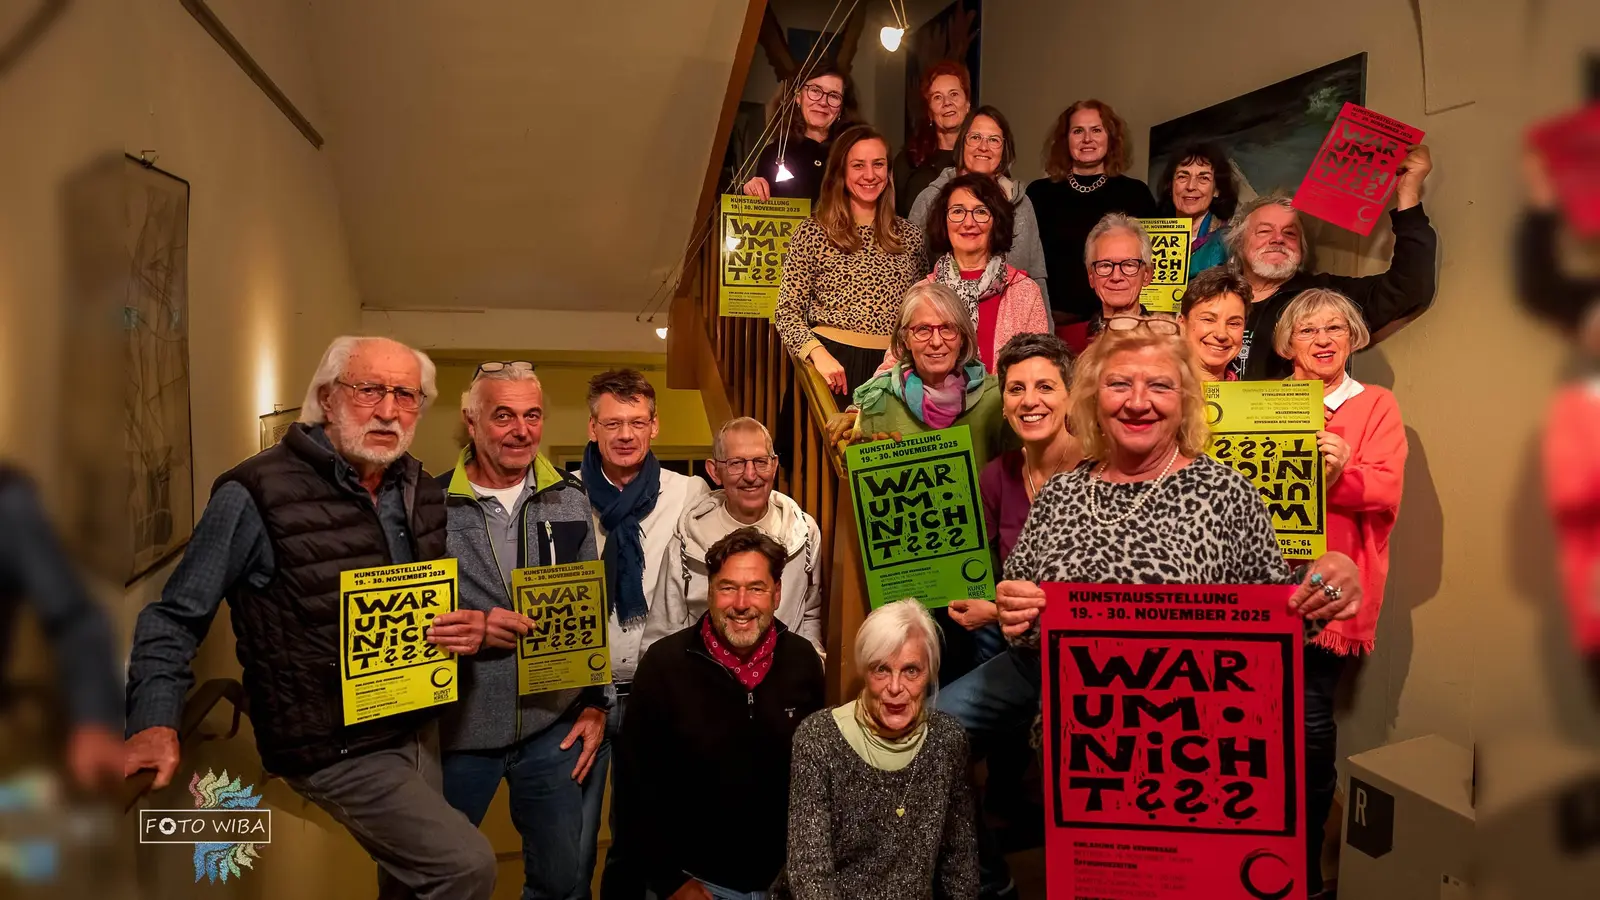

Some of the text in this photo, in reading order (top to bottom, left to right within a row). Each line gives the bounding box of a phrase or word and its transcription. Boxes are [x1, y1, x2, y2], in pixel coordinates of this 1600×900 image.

[1343, 124, 1398, 158] WAR
[730, 218, 792, 238] WAR
[860, 434, 942, 455] KUNSTAUSSTELLUNG
[861, 454, 873, 463] 19.
[879, 452, 892, 460] 30.
[893, 446, 938, 458] NOVEMBER
[939, 441, 958, 450] 2025
[862, 464, 956, 497] WAR
[1278, 538, 1291, 546] 30.
[1298, 538, 1311, 546] 19.
[1276, 548, 1312, 556] KUNST
[354, 564, 432, 579] KUNSTAUSSTELLUNG
[355, 578, 366, 586] 19.
[372, 576, 384, 584] 30.
[386, 572, 428, 583] NOVEMBER
[429, 569, 446, 578] 2025
[524, 565, 584, 576] KUNSTAUSSTELLUNG
[524, 585, 591, 605] WAR
[967, 584, 987, 592] KUNST
[354, 590, 440, 615] WAR
[1068, 591, 1239, 604] KUNSTAUSSTELLUNG
[1071, 608, 1092, 620] 19.
[1107, 608, 1131, 620] 30.
[1135, 609, 1226, 621] NOVEMBER
[1231, 609, 1271, 622] 2025
[1069, 646, 1255, 692] WAR
[1354, 786, 1367, 826] R
